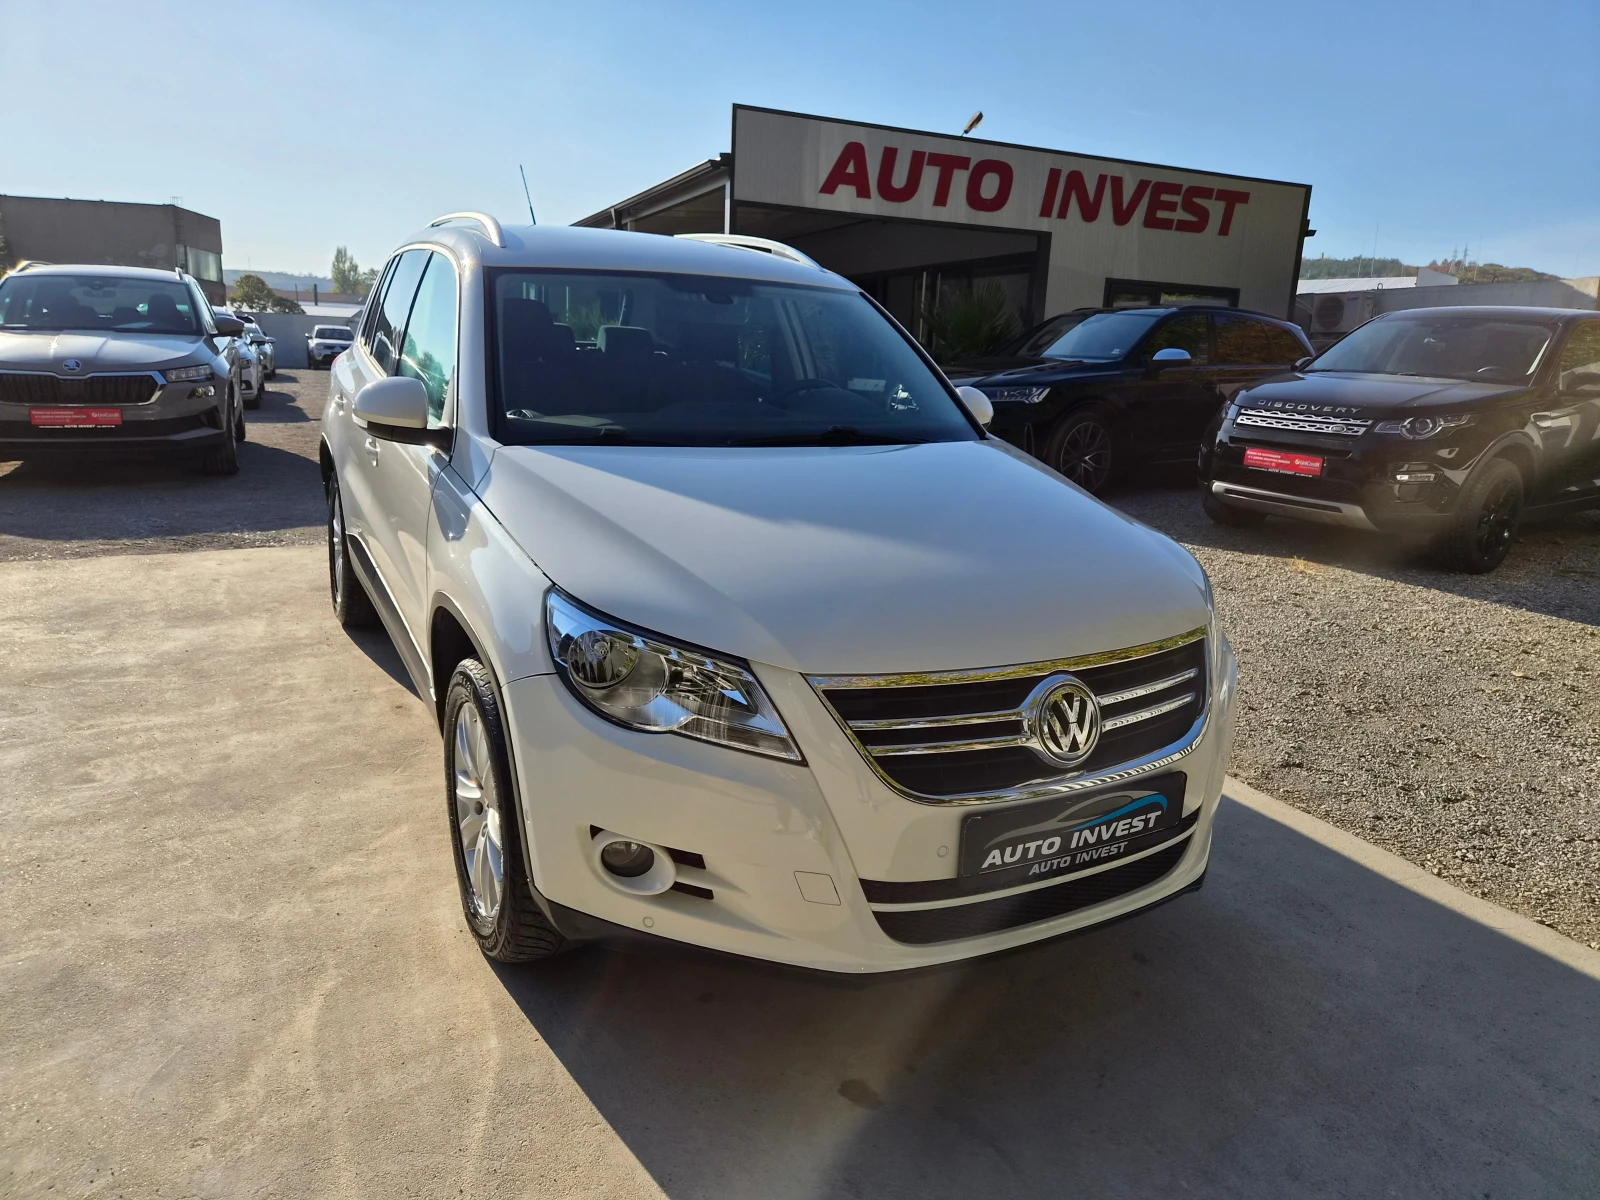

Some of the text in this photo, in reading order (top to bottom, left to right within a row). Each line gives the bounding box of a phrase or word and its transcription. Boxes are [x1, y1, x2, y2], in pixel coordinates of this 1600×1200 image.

[818, 141, 1250, 236] AUTO INVEST
[1258, 399, 1361, 414] DISCOVERY
[1299, 459, 1321, 468] UniCredit
[981, 810, 1162, 869] AUTO INVEST
[1028, 841, 1128, 876] AUTO INVEST
